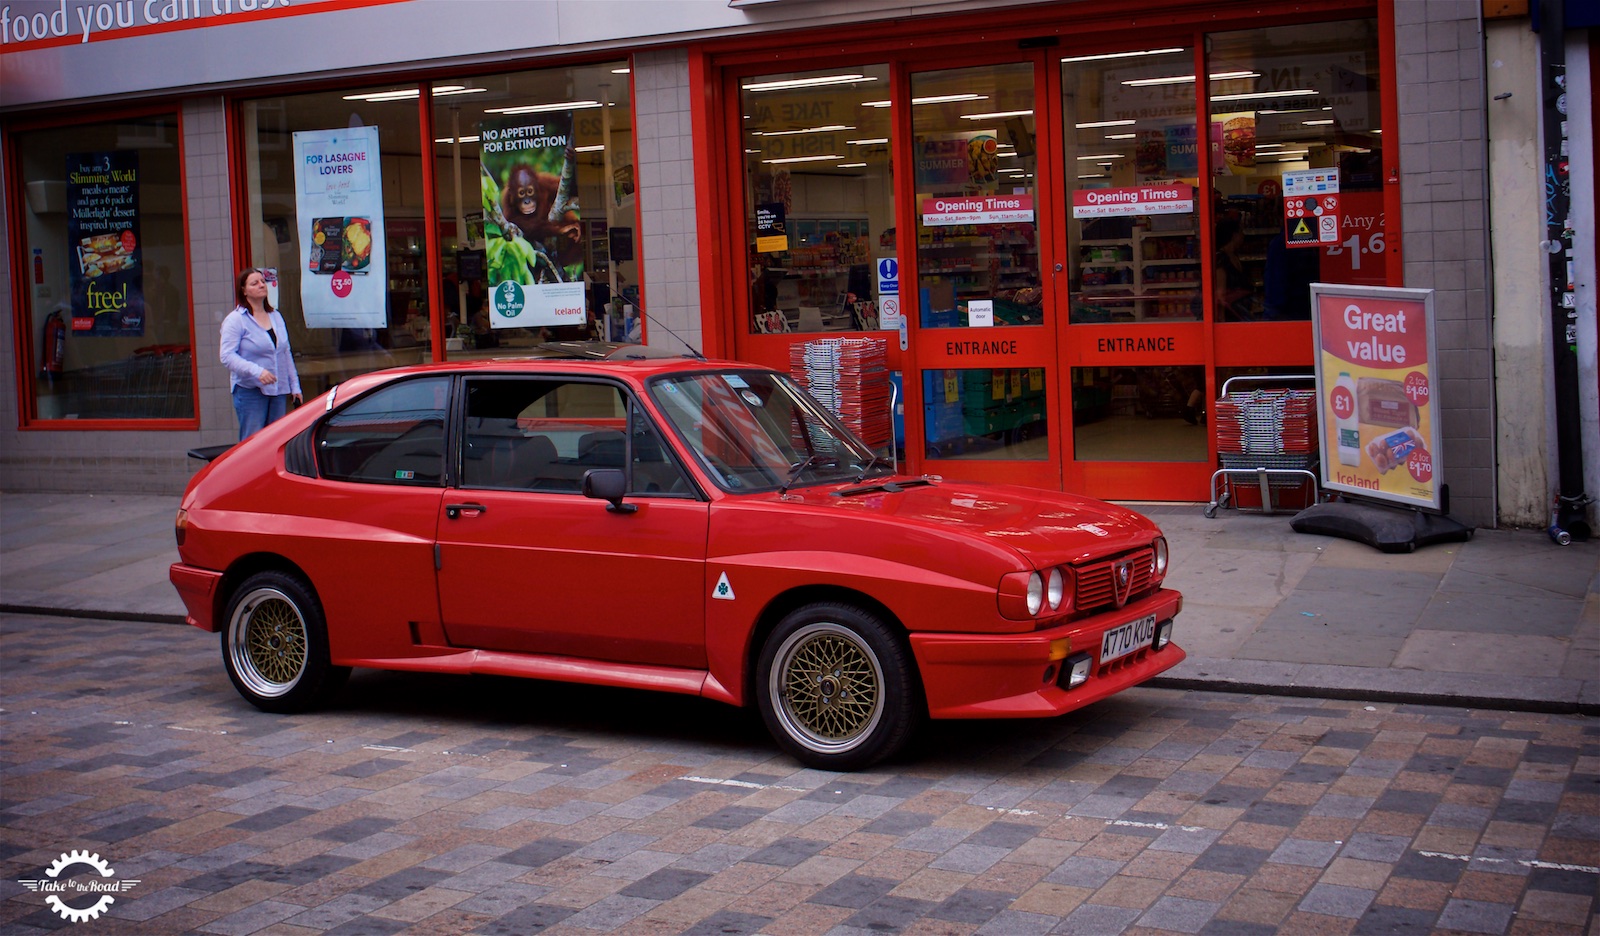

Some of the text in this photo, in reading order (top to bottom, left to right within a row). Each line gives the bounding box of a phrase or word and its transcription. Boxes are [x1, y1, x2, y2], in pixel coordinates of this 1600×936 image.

[0, 0, 69, 44] food
[76, 0, 135, 44] you
[482, 125, 545, 141] NO APPETITE
[483, 135, 567, 153] FOR EXTINCTION
[1171, 142, 1219, 155] SUMR
[103, 156, 111, 172] 3
[306, 152, 366, 164] FOR LASAGNE
[919, 158, 964, 171] SUMMER
[69, 169, 136, 185] Slimming World
[320, 165, 354, 175] LOVERS
[1086, 188, 1178, 205] Opening Times
[935, 198, 1020, 213] Opening Times
[1342, 214, 1375, 231] Any
[332, 278, 352, 290] £3.50
[87, 281, 127, 309] free!
[497, 302, 507, 310] No
[554, 307, 582, 316] Iceland
[1343, 304, 1407, 334] Great
[946, 340, 1018, 355] ENTRANCE
[1097, 337, 1175, 352] ENTRANCE
[1346, 336, 1406, 364] value
[1408, 376, 1426, 386] 2 for
[1406, 385, 1429, 400] £1.60
[1335, 395, 1350, 411] £1
[1412, 451, 1429, 462] 2 for
[1409, 460, 1432, 477] £1.70
[1336, 471, 1380, 491] Iceland
[1102, 616, 1155, 658] A770 KUG
